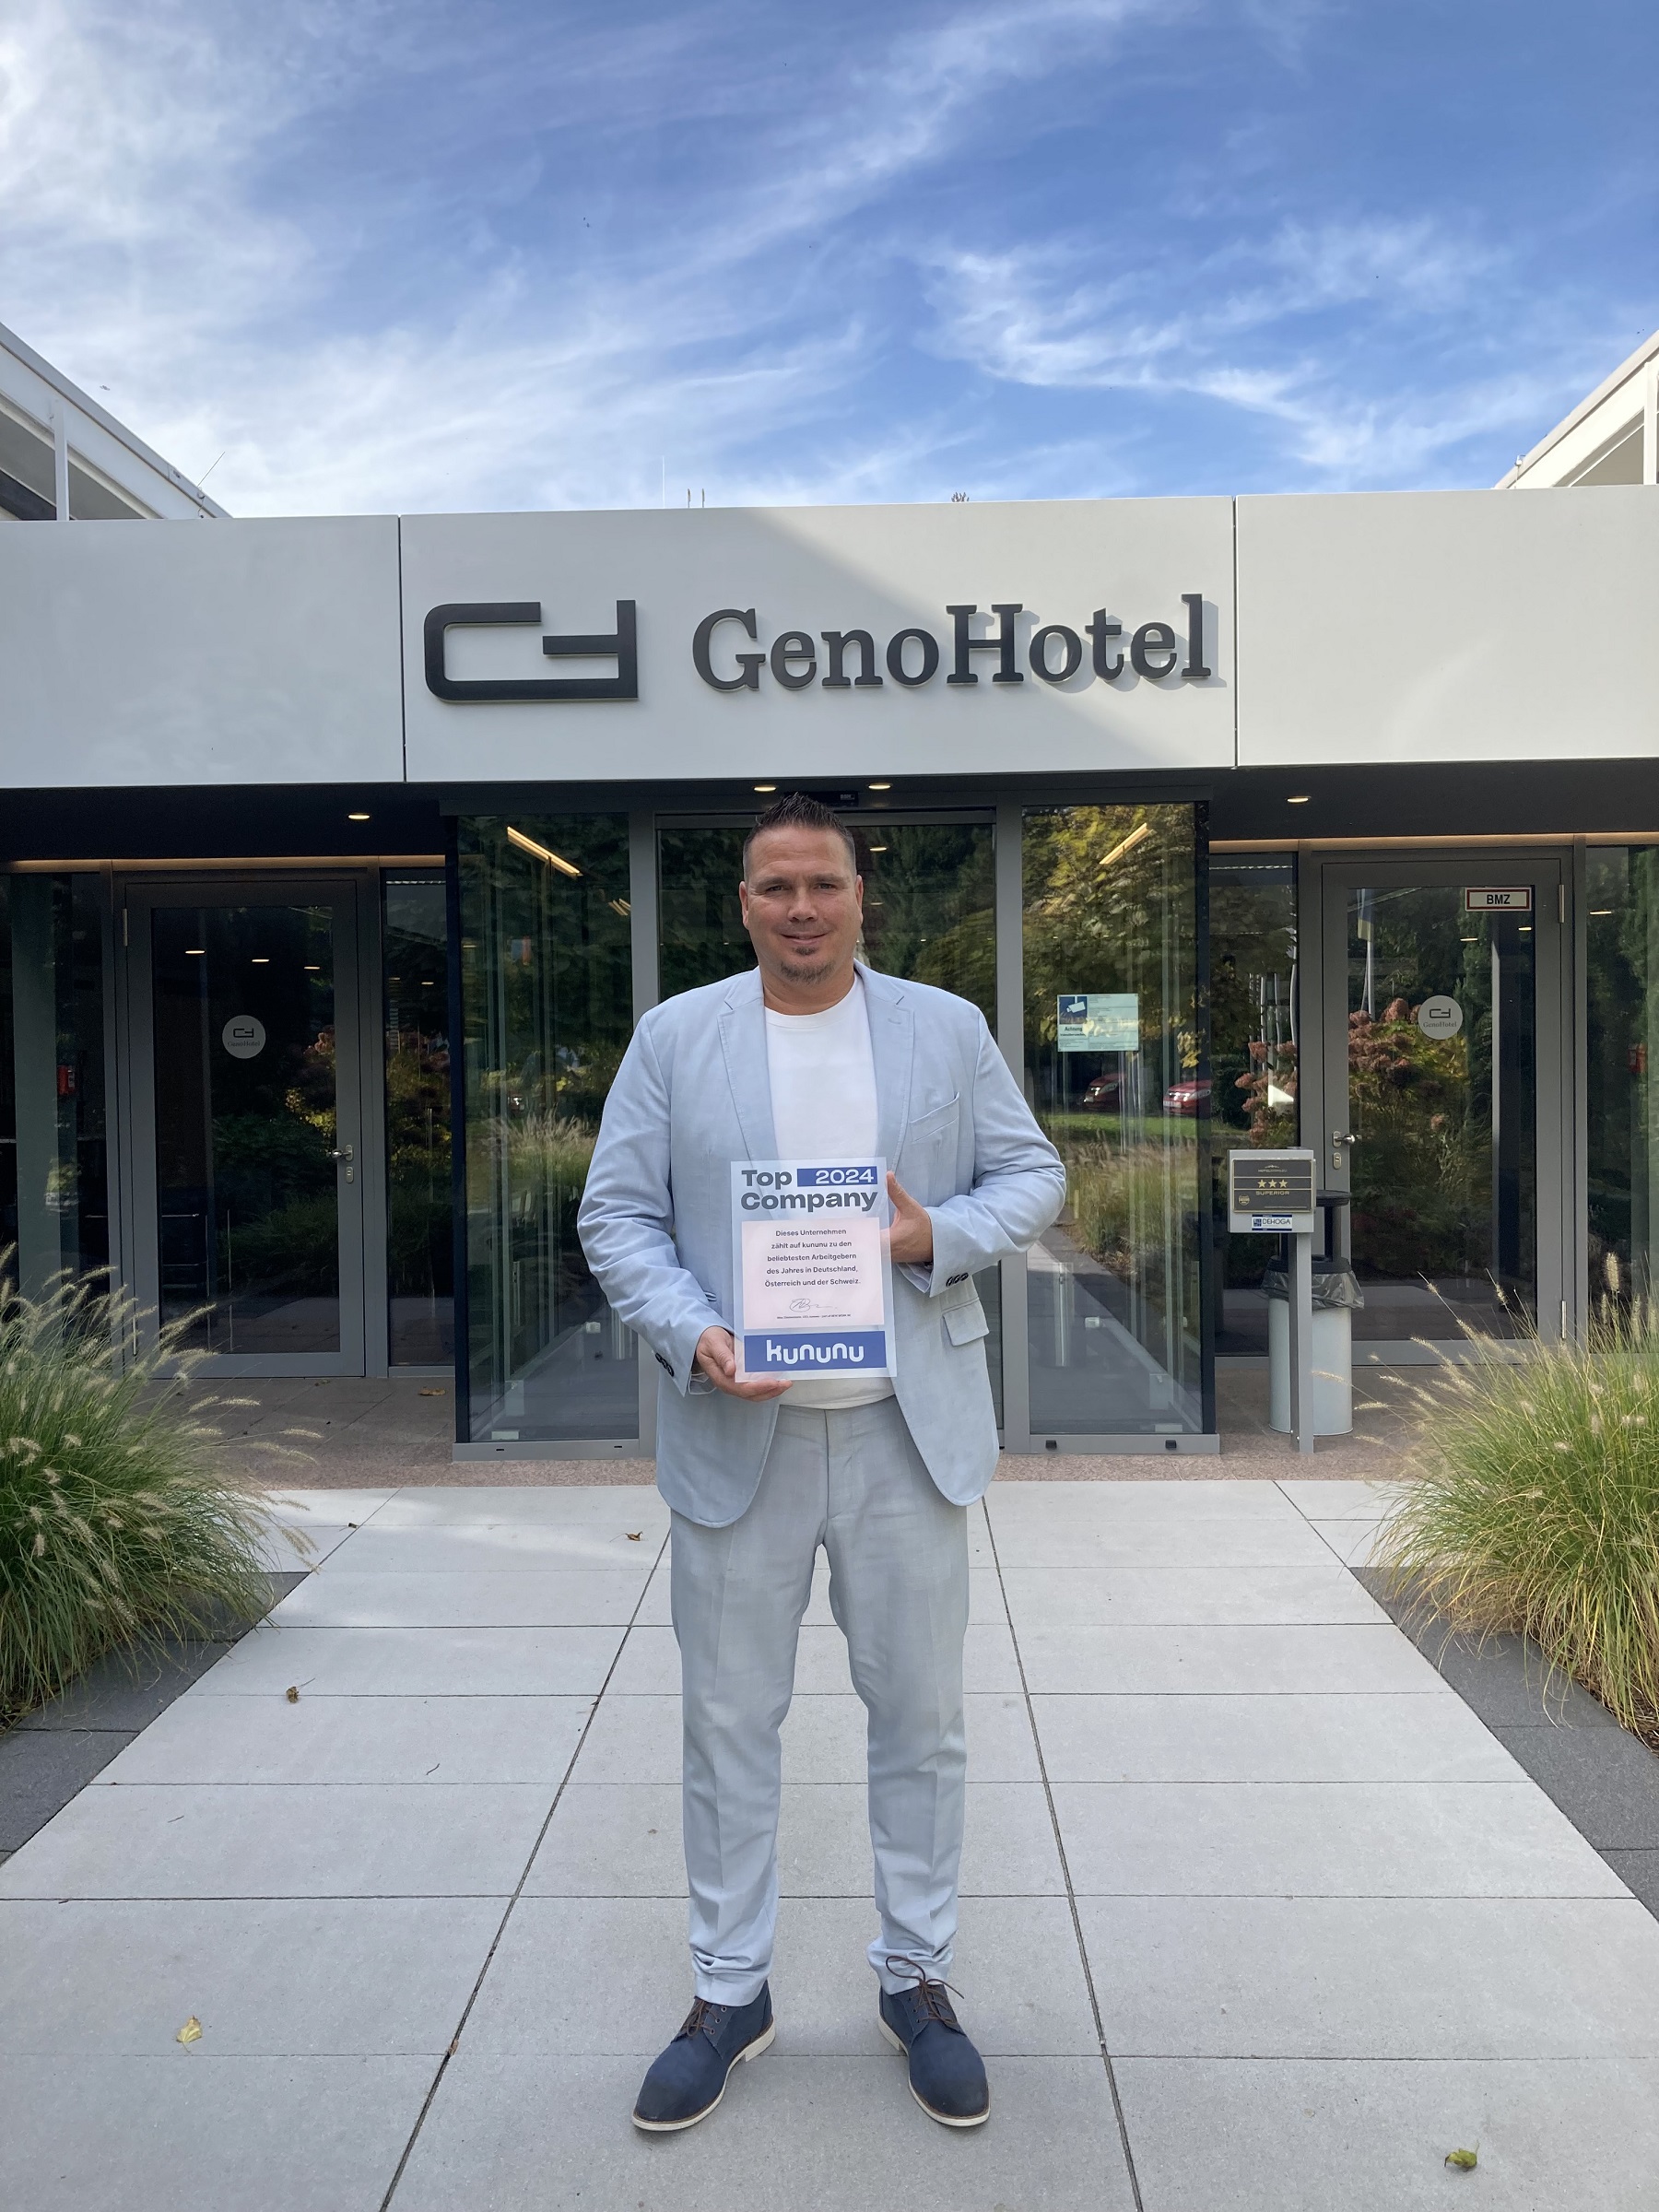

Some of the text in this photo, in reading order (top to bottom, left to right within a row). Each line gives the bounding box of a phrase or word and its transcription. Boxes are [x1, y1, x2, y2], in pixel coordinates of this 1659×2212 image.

[692, 593, 1212, 692] GenoHotel
[1487, 894, 1510, 904] BMZ
[741, 1169, 874, 1190] Top 2024
[741, 1191, 878, 1212] Company
[765, 1279, 801, 1288] Österreich
[830, 1277, 861, 1286] Schweiz.
[766, 1339, 865, 1364] kununu
